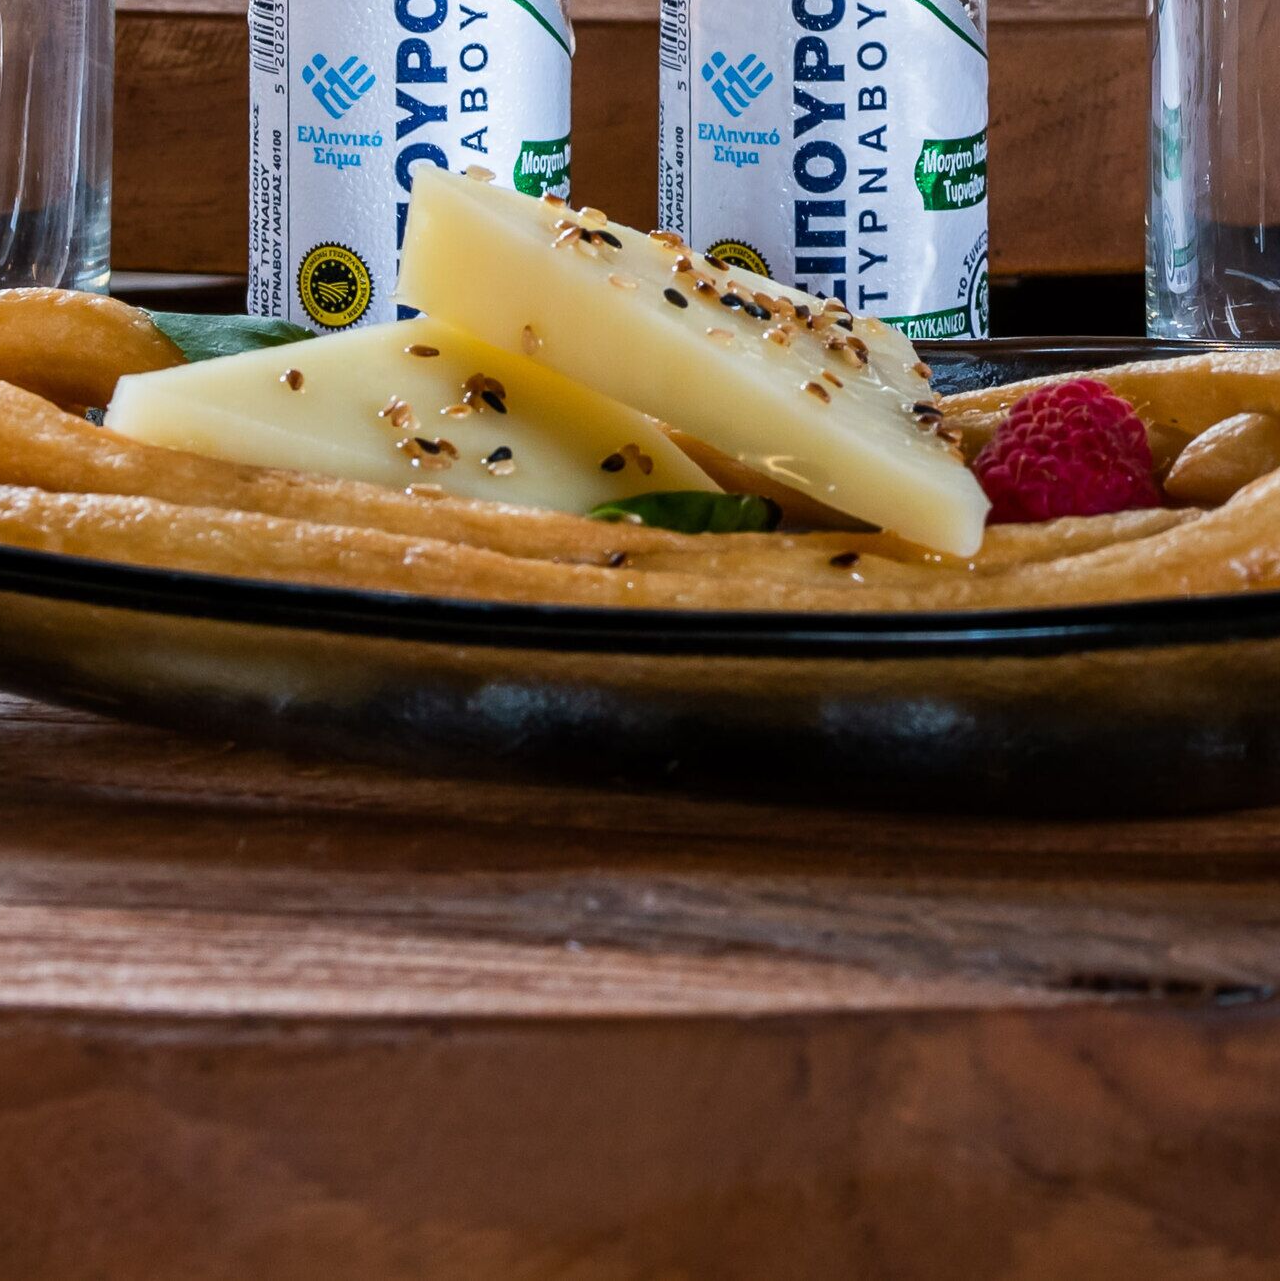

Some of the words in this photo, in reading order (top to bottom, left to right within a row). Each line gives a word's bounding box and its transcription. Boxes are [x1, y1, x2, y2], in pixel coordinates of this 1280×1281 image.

[459, 4, 489, 175] ΑΒΟΥ
[298, 126, 383, 147] Ελληνικό
[698, 123, 780, 145] Ελληνικό
[314, 147, 361, 170] Σήμα
[714, 145, 759, 168] Σήμα
[856, 3, 888, 310] ΤΥΡΝΑΒΟΥ
